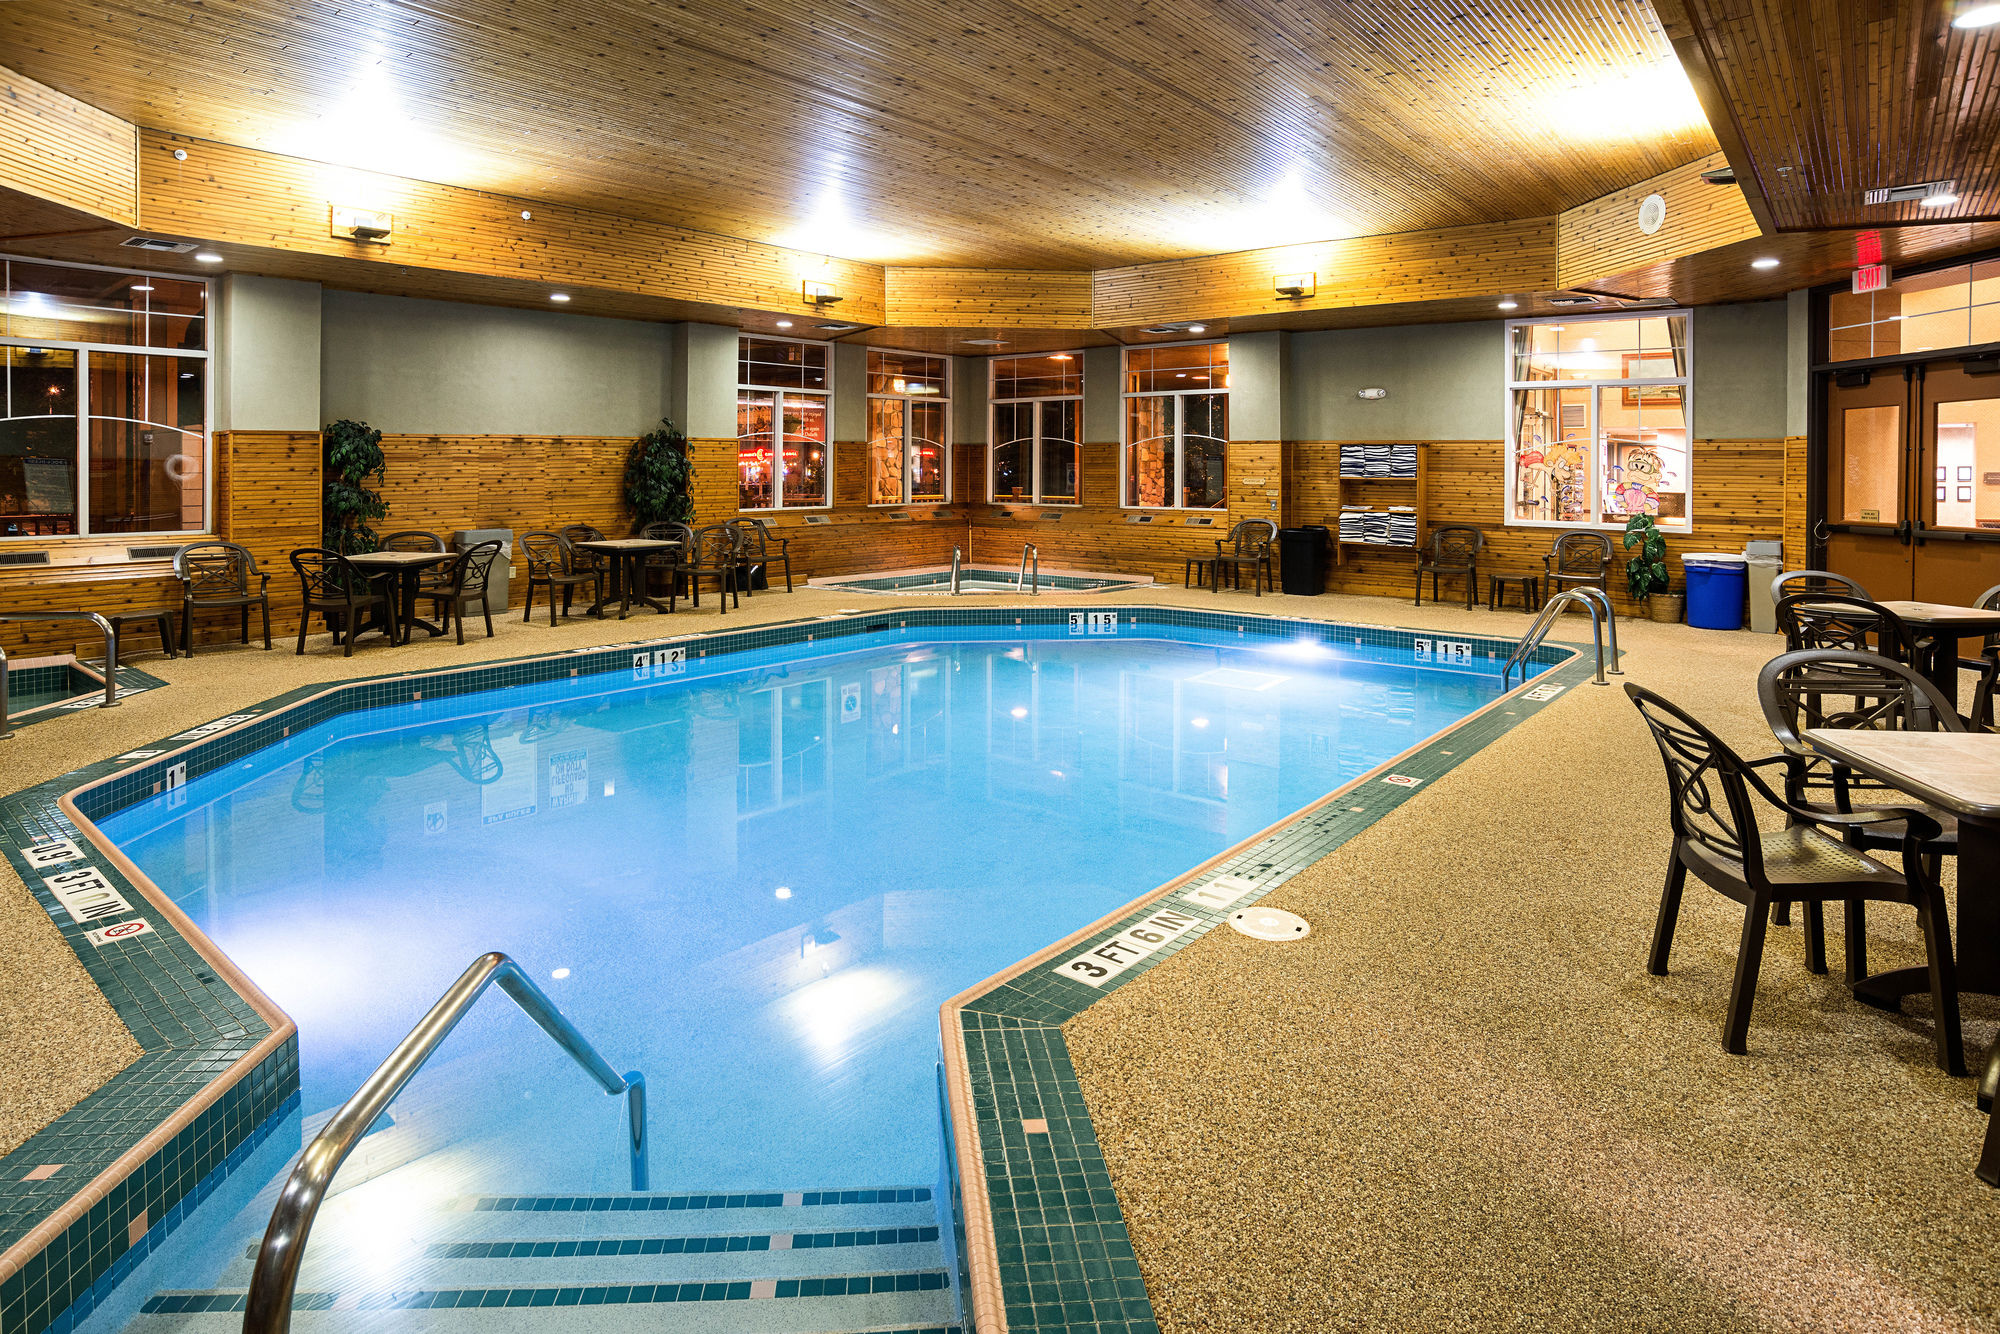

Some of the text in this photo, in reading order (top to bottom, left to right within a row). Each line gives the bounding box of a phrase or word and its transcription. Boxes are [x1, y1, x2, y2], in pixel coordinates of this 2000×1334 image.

[1858, 265, 1882, 291] EXIT
[54, 871, 92, 883] 3
[1071, 911, 1194, 977] 3 FT 6 IN
